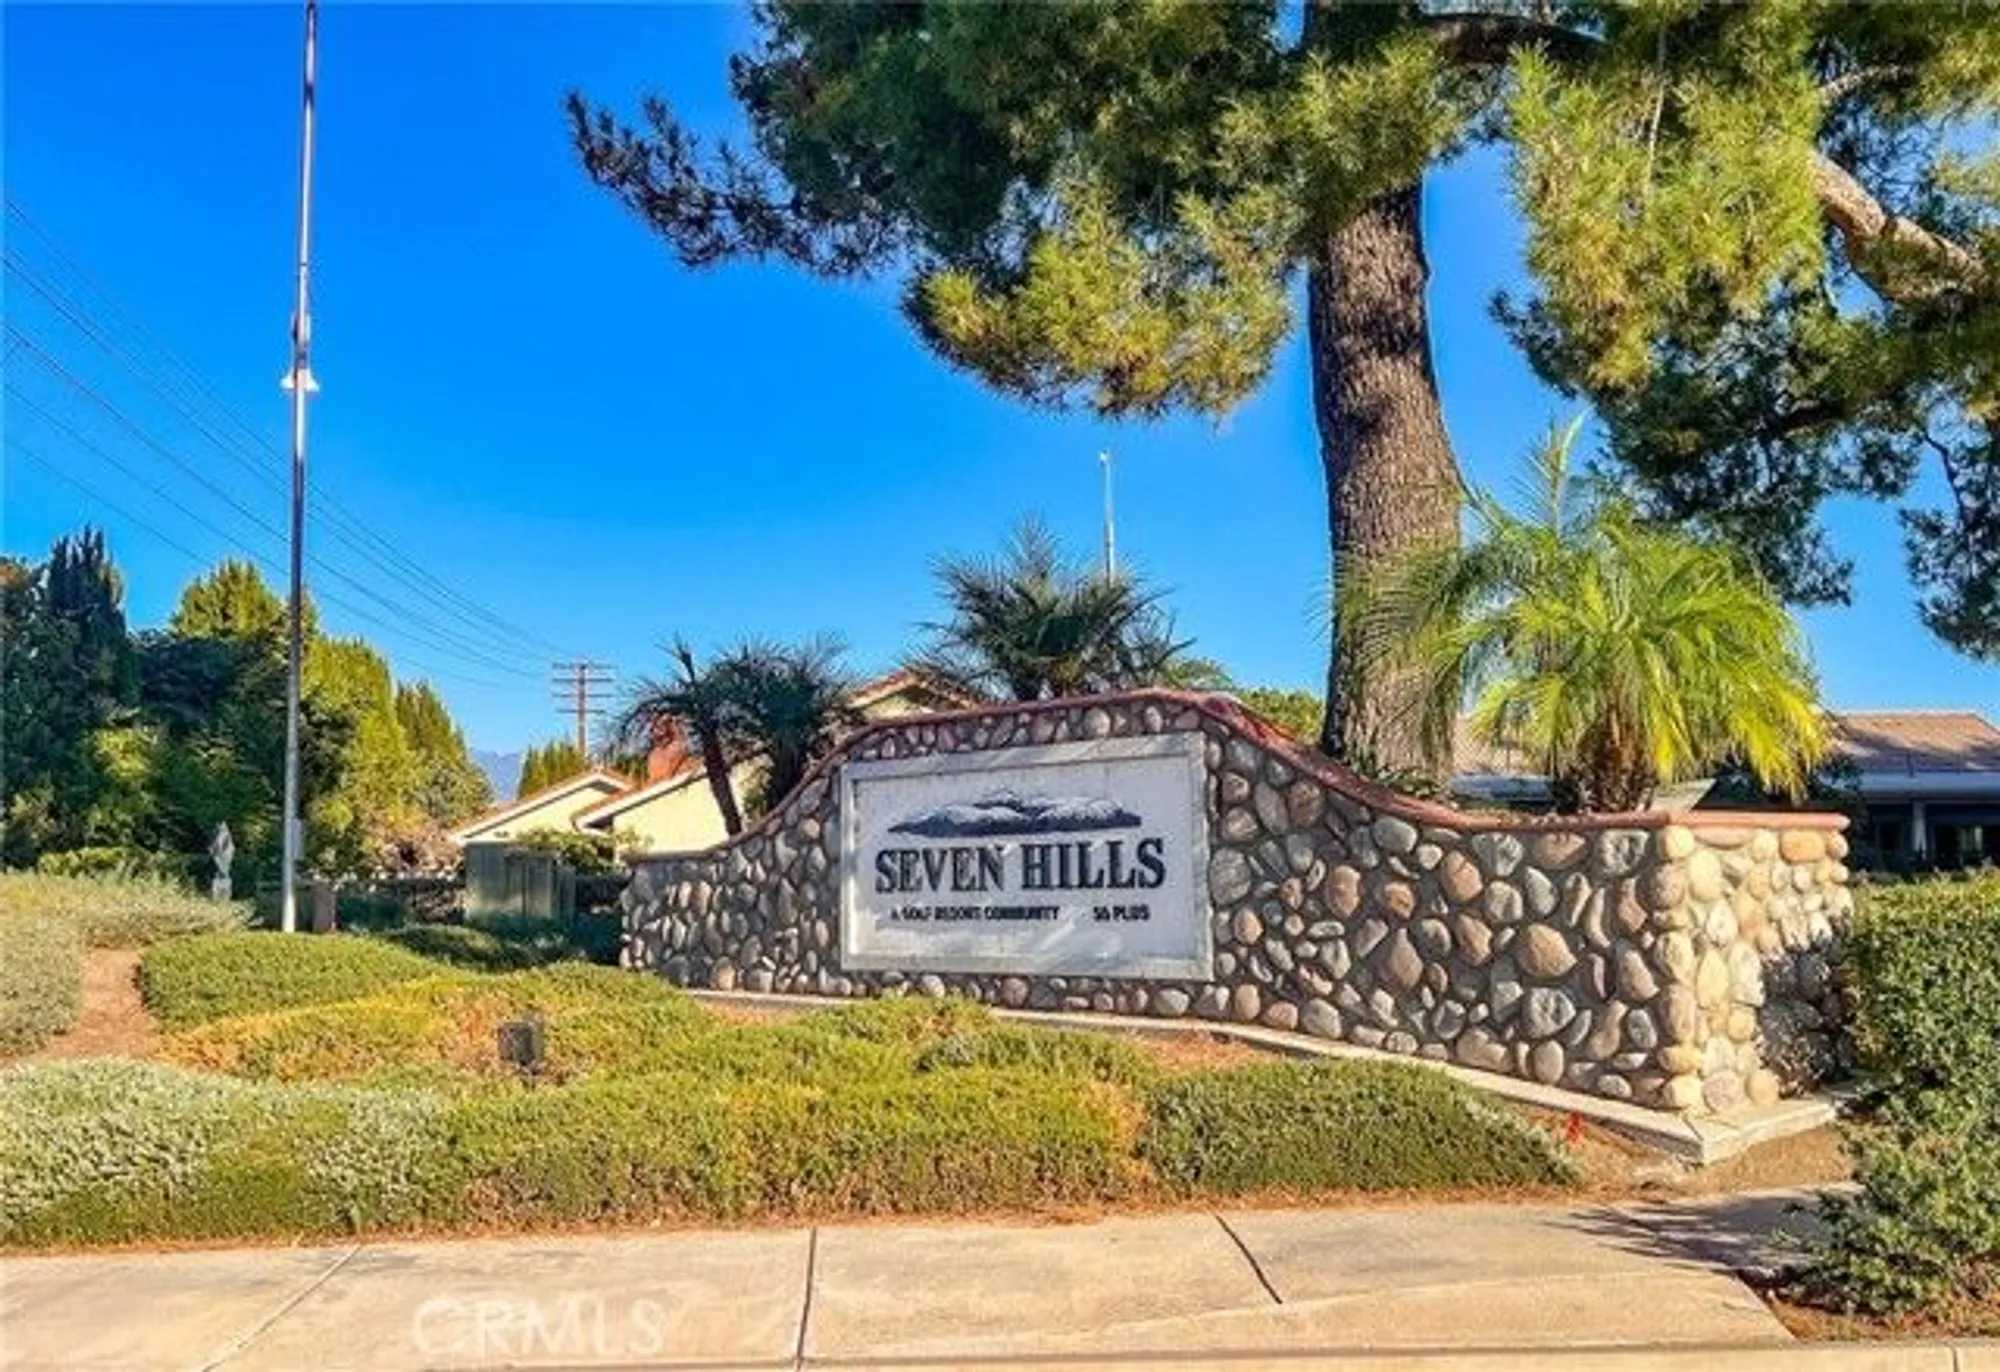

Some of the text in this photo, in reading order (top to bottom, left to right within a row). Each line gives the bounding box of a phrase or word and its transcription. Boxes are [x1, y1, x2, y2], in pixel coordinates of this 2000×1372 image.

[875, 837, 1166, 893] SEVEN HILLS
[902, 906, 932, 920] GOLF
[984, 906, 1060, 921] COMMUNITY
[1113, 904, 1150, 921] PLUS
